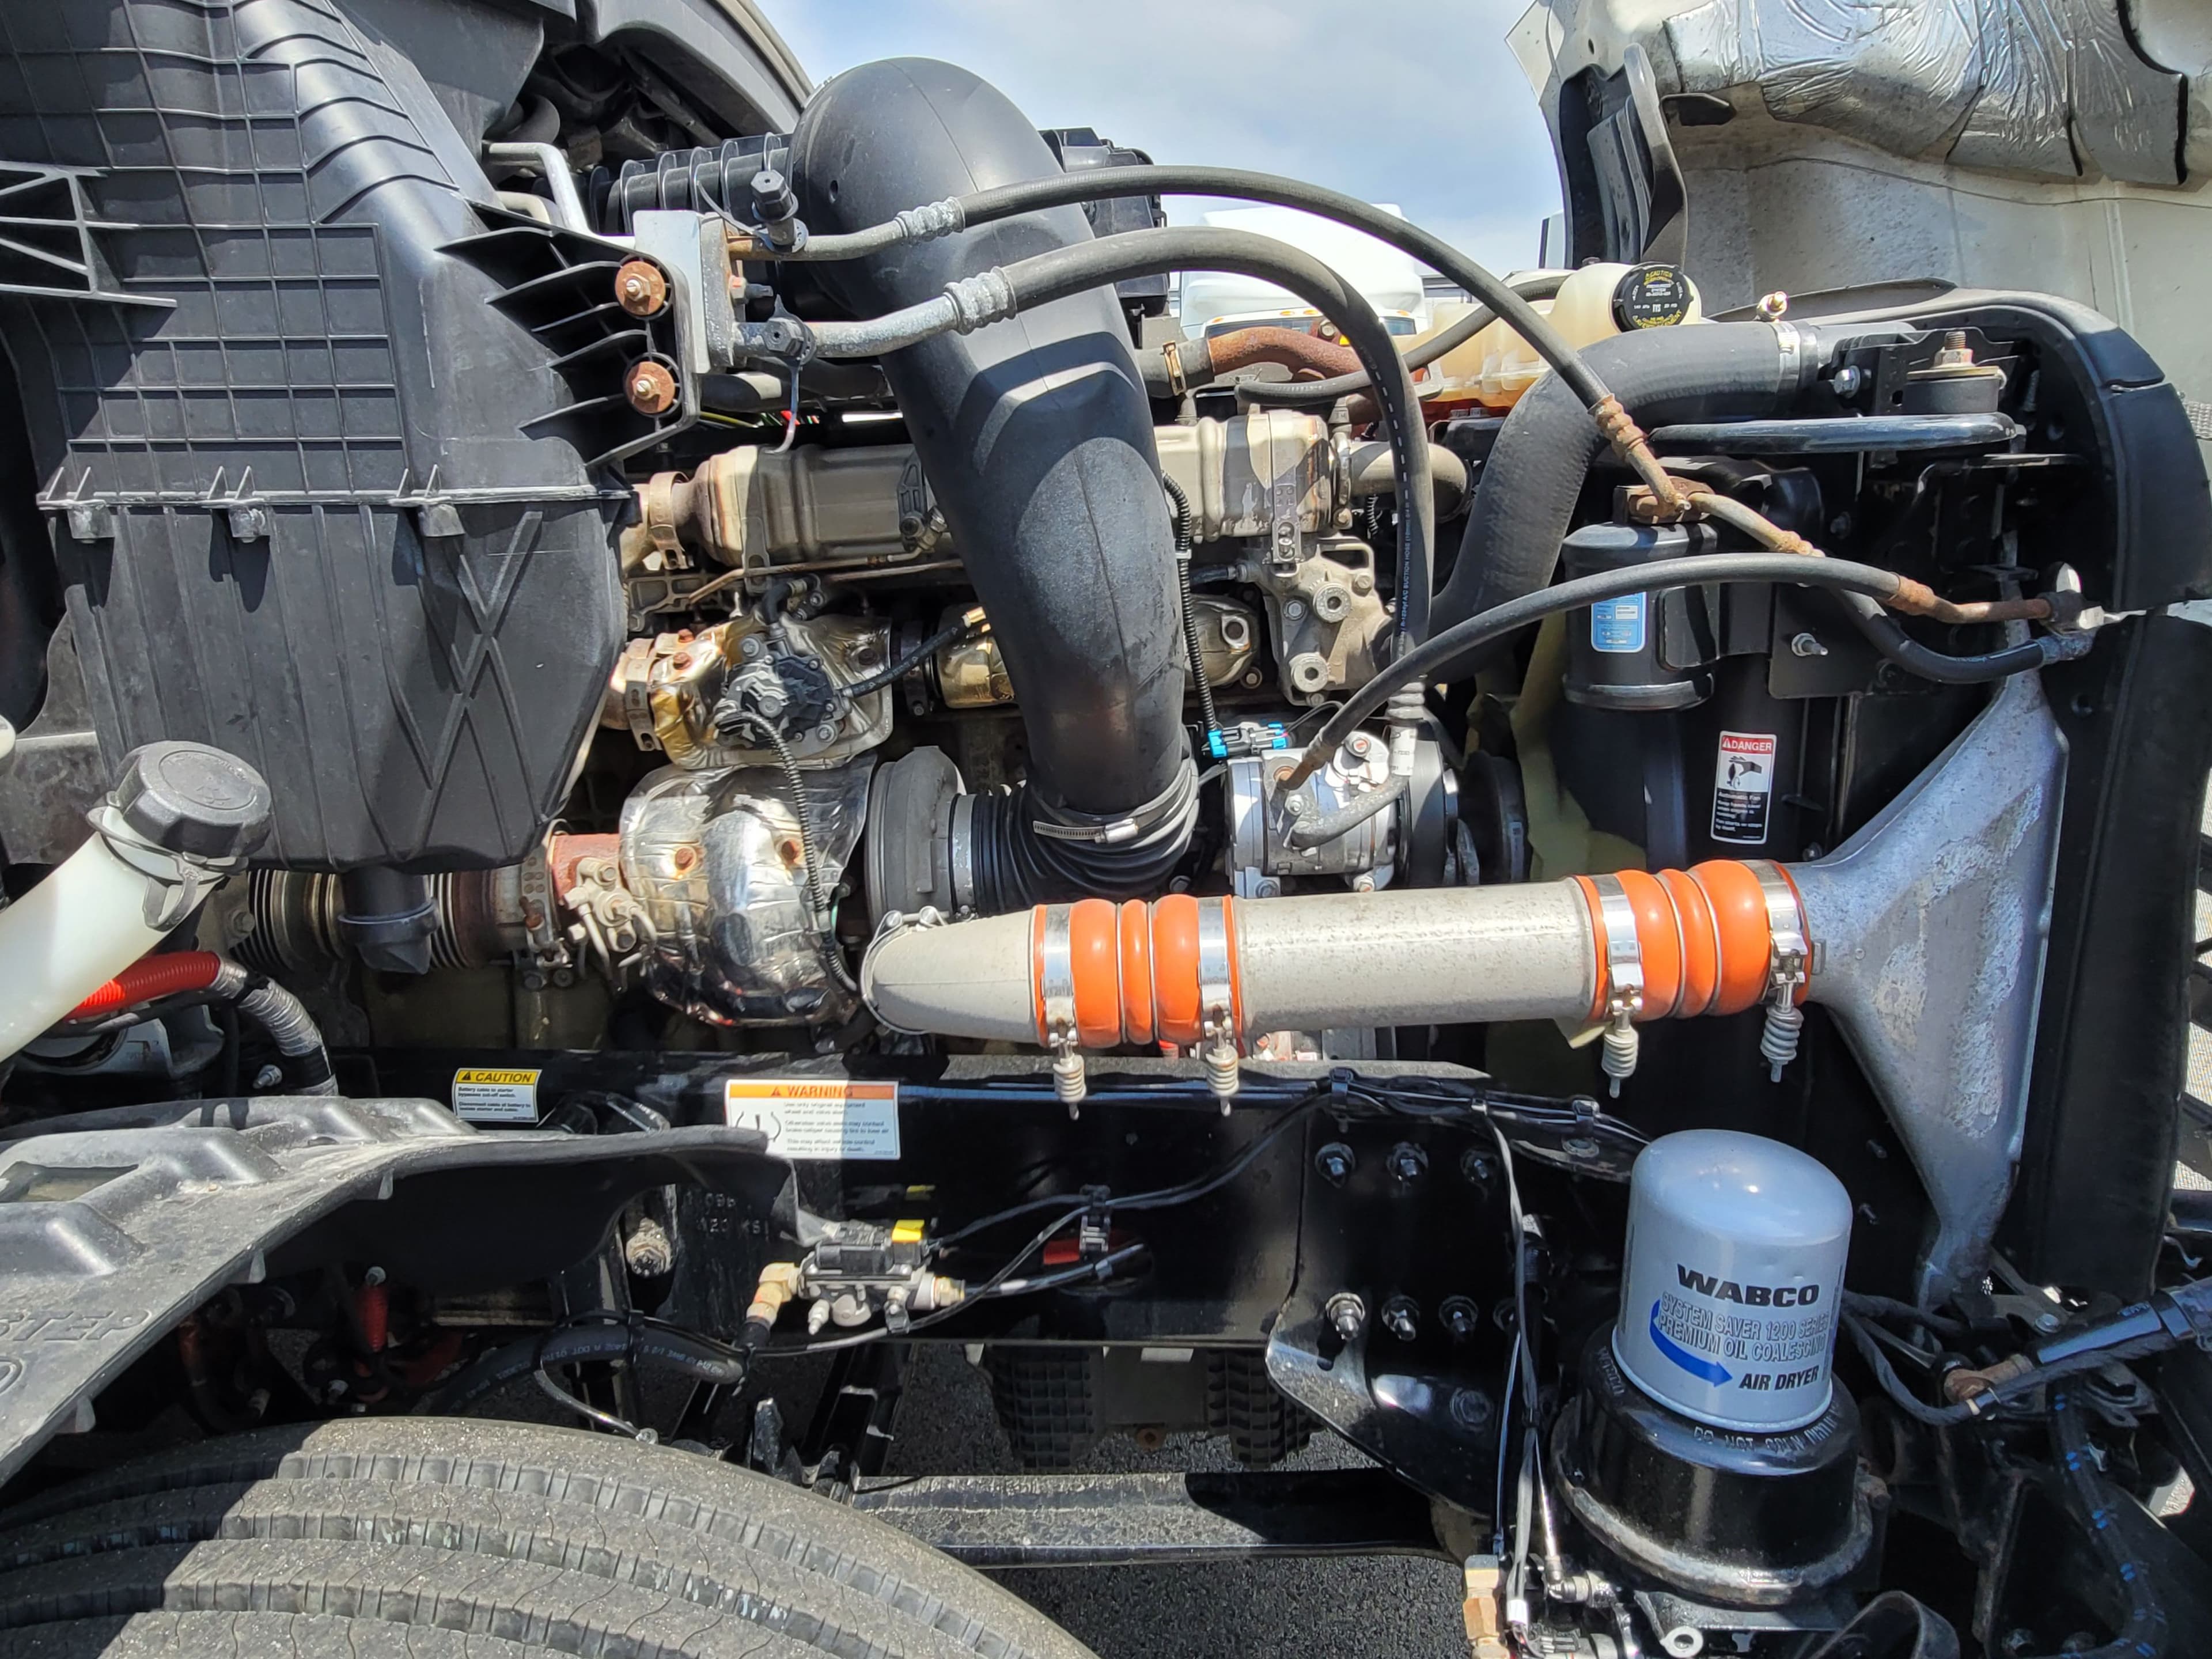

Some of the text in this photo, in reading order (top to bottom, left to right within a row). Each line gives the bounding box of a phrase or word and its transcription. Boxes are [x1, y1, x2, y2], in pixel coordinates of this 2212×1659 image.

[1732, 741, 1772, 751] DANGER
[475, 1072, 532, 1082] CAUTION
[787, 1085, 853, 1097] WARNING
[1677, 1263, 1820, 1308] WABCO
[1661, 1292, 1713, 1331] SYSTEM
[1715, 1315, 1762, 1341] SAVER
[1766, 1321, 1797, 1342] 1200
[1658, 1313, 1721, 1355] PREMIUM
[1724, 1338, 1748, 1361] OIL
[1738, 1365, 1820, 1391] AIR DRYER
